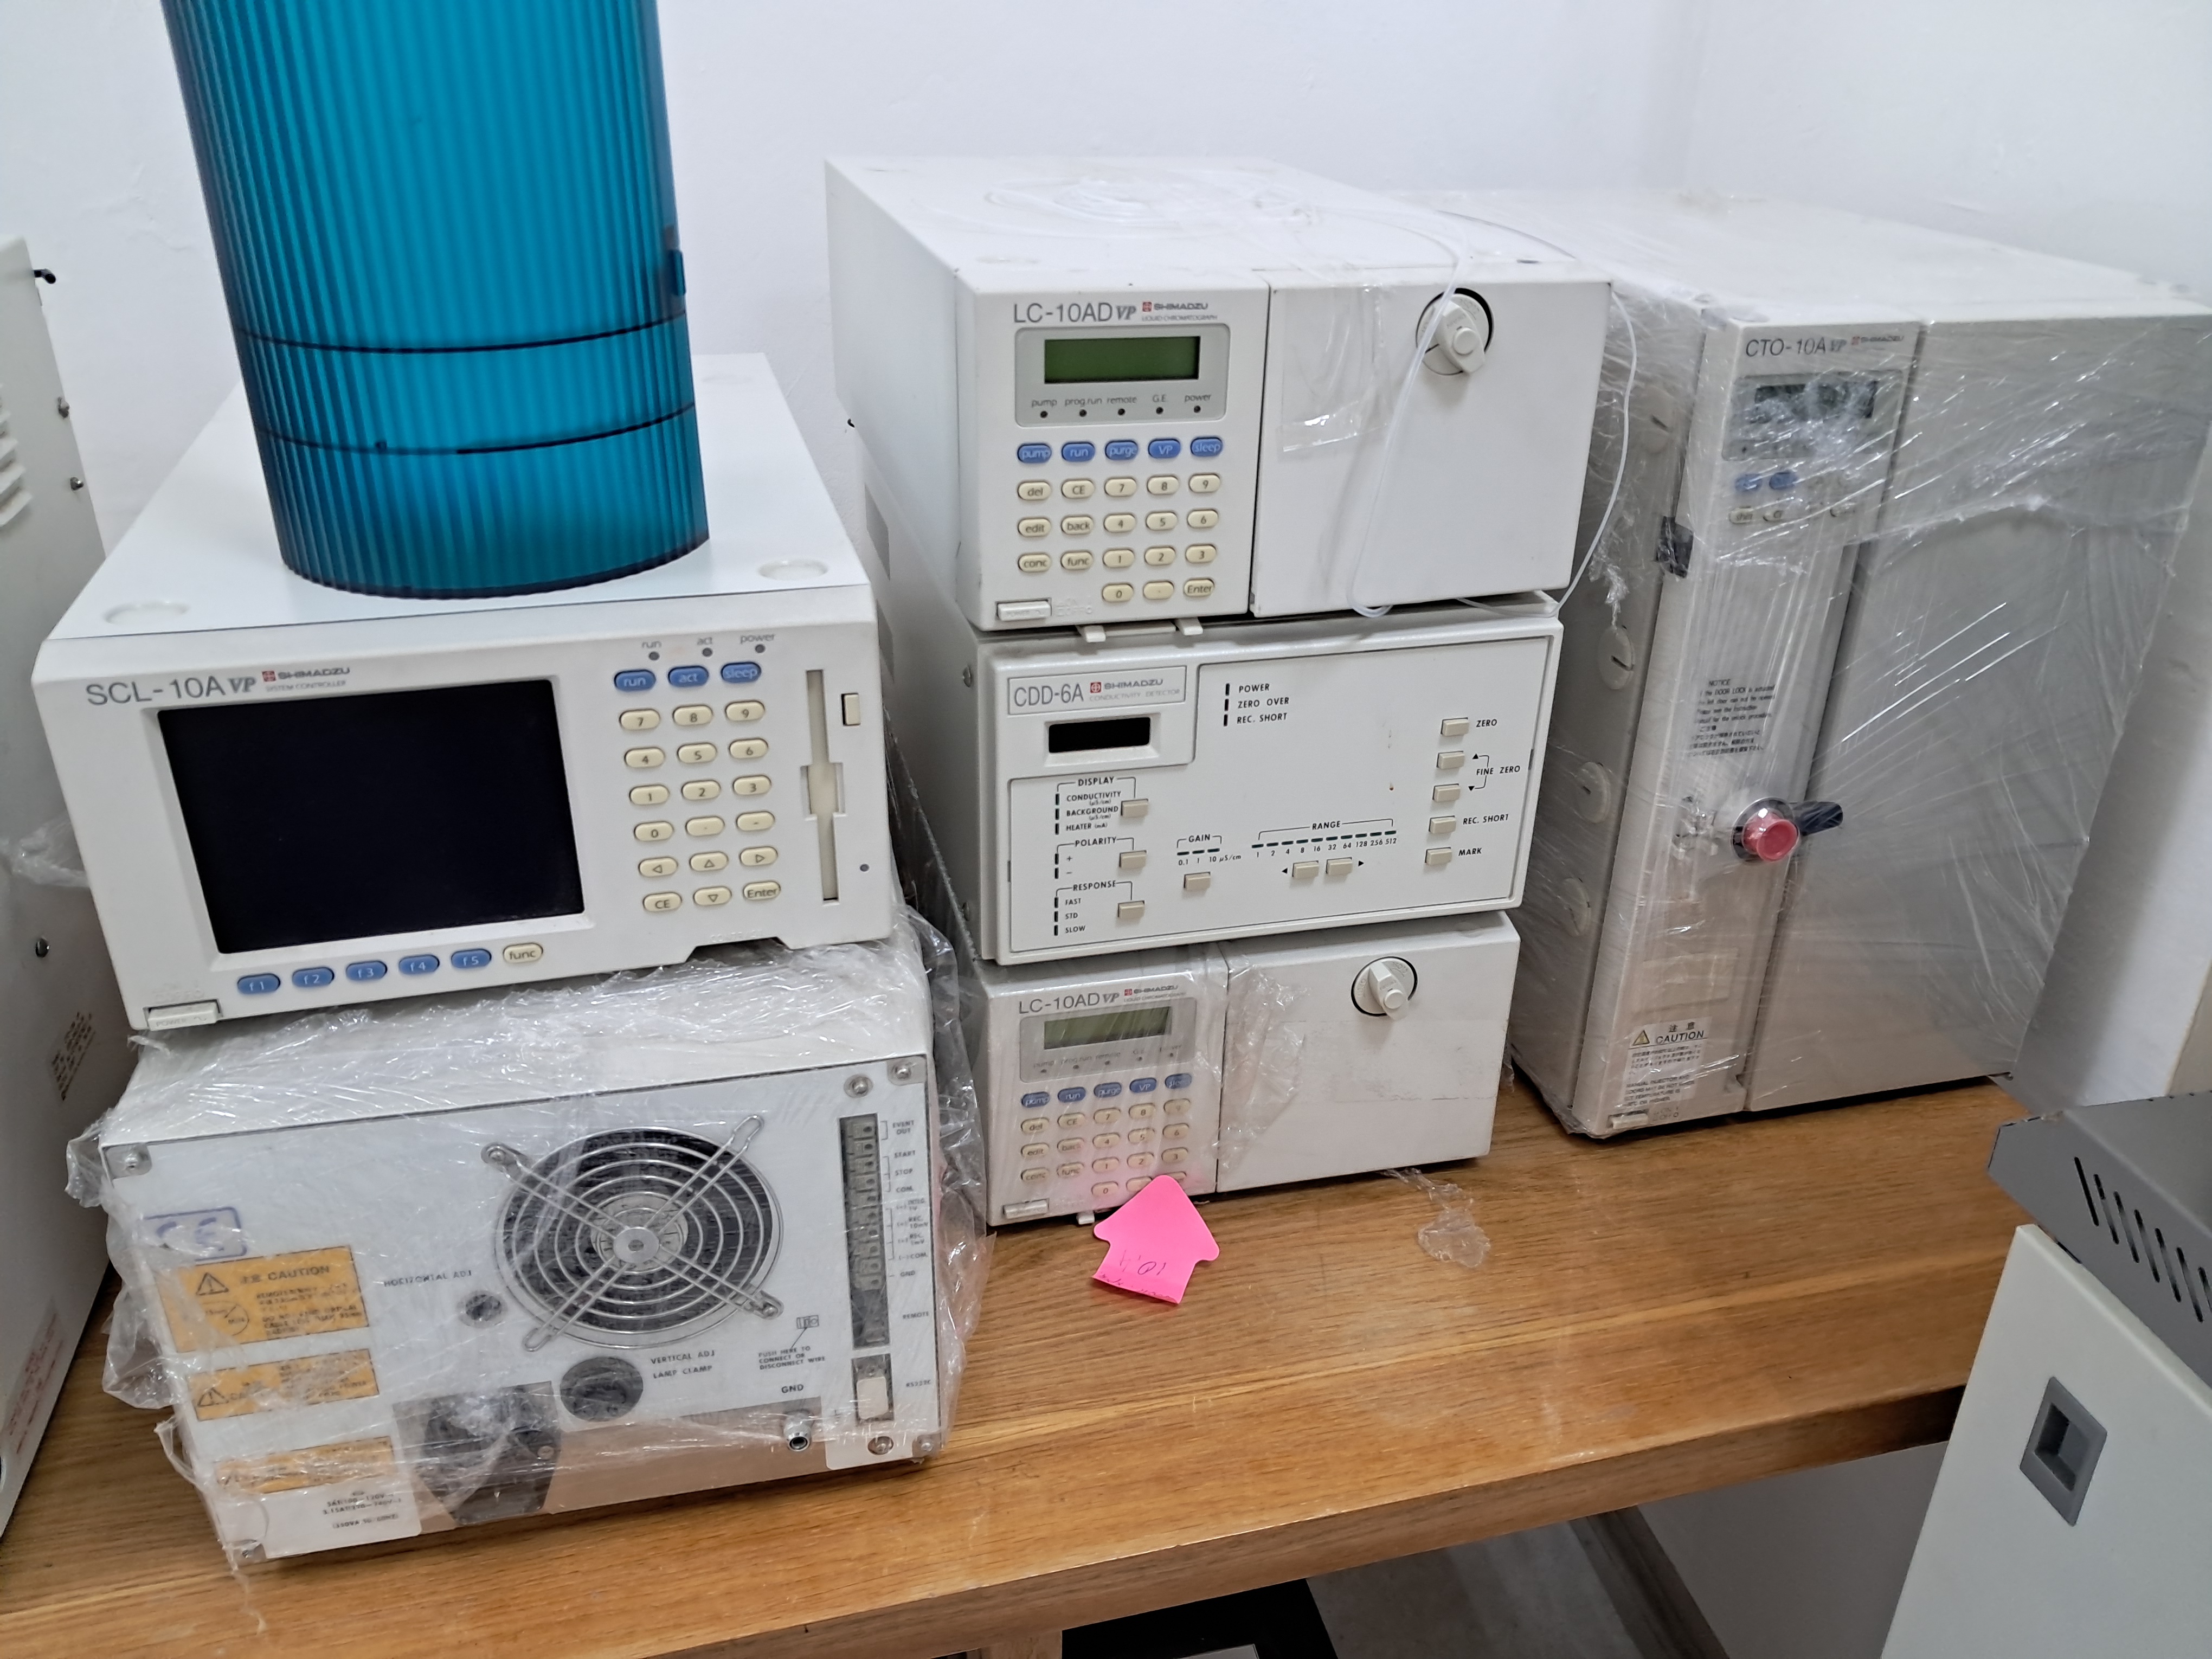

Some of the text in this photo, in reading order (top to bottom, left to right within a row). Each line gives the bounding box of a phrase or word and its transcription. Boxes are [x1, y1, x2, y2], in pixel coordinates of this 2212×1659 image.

[1107, 395, 1137, 404] remote
[1184, 393, 1211, 402] power
[1032, 398, 1057, 408] pump
[1110, 446, 1138, 457] purge
[1159, 445, 1173, 455] VP
[1194, 442, 1220, 453] sleep
[1022, 450, 1050, 460] pump
[1070, 449, 1089, 457] run
[1119, 484, 1125, 492] 7
[1161, 482, 1168, 491] 8
[1203, 480, 1208, 488] 9
[1027, 487, 1043, 497] del
[1072, 485, 1085, 494] CE
[1118, 519, 1123, 529] 4
[1160, 518, 1166, 526] 5
[1200, 516, 1206, 524] 6
[1026, 524, 1045, 533] edit
[1067, 522, 1091, 531] back
[1158, 552, 1165, 562] 2
[1199, 551, 1205, 560] 3
[1024, 560, 1047, 568] conc
[1067, 556, 1089, 567] func
[1187, 583, 1213, 594] Enter
[1116, 589, 1122, 599] 0
[697, 636, 713, 645] act
[740, 633, 776, 645] power
[641, 640, 662, 649] run
[678, 673, 699, 683] act
[724, 667, 758, 679] sleep
[623, 677, 646, 687] run
[1014, 679, 1163, 707] CDD-6A SHIMADZU
[1238, 683, 1270, 693] POWER
[1237, 697, 1290, 709] ZERO OVER
[690, 712, 698, 723] 8
[742, 709, 749, 718] 9
[1237, 712, 1288, 725] REC. SHORT
[637, 717, 644, 726] 7
[1476, 719, 1498, 728] ZERO
[695, 751, 702, 760] 5
[746, 746, 753, 756] 6
[642, 755, 648, 764] 4
[1476, 765, 1521, 776] FINE ZERO
[1078, 776, 1115, 787] DISPLAY
[699, 788, 705, 796] 2
[750, 783, 757, 792] 3
[1066, 790, 1122, 802] CONDUCTIVITY
[1066, 806, 1119, 817] BACKGROUND
[1463, 813, 1509, 825] REC. SHORT
[1066, 823, 1092, 832] HEATER
[1311, 820, 1341, 831] RANGE
[651, 829, 659, 838] 0
[1188, 833, 1211, 843] GAIN
[1075, 835, 1117, 847] POLARITY
[1385, 837, 1397, 845] 512
[1458, 847, 1482, 857] MARK
[1072, 880, 1116, 891] RESPONSE
[747, 887, 777, 898] Enter
[654, 899, 671, 909] CE
[1065, 897, 1082, 905] FAST
[1065, 912, 1078, 920] STD
[1065, 925, 1086, 934] SLOW
[508, 949, 536, 960] func
[1655, 1030, 1705, 1044] CAUTION
[1139, 1083, 1151, 1092] VP
[1065, 1092, 1081, 1101] run
[1066, 1118, 1077, 1126] CE
[896, 1127, 912, 1135] OUT
[894, 1150, 916, 1159] START
[1027, 1147, 1044, 1156] edit
[895, 1168, 914, 1176] STOP
[1061, 1167, 1081, 1176] func
[267, 1265, 331, 1281] CAUTION
[902, 1311, 929, 1320] REMOTE
[651, 1353, 692, 1365] VERTICAL
[759, 1354, 792, 1364] CONNECT
[760, 1359, 804, 1370] DISCONNECT
[653, 1365, 713, 1379] LAMP CLAMP
[781, 1384, 804, 1393] GND
